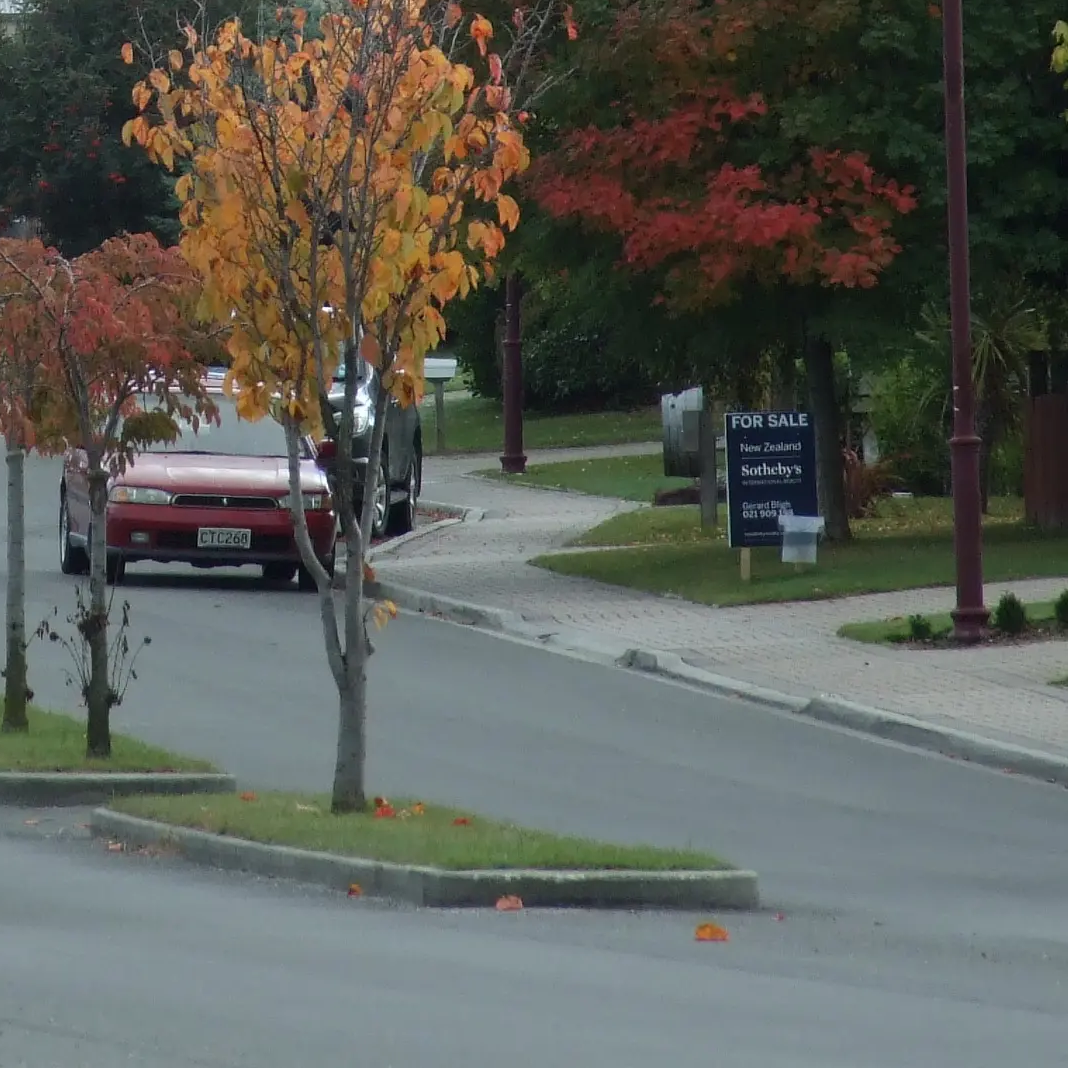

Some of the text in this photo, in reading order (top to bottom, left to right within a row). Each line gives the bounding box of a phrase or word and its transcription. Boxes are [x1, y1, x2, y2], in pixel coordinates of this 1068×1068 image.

[732, 413, 808, 429] FOR SALE
[740, 441, 801, 452] New Zealand
[741, 462, 802, 478] Sotheby's
[742, 510, 758, 519] 021
